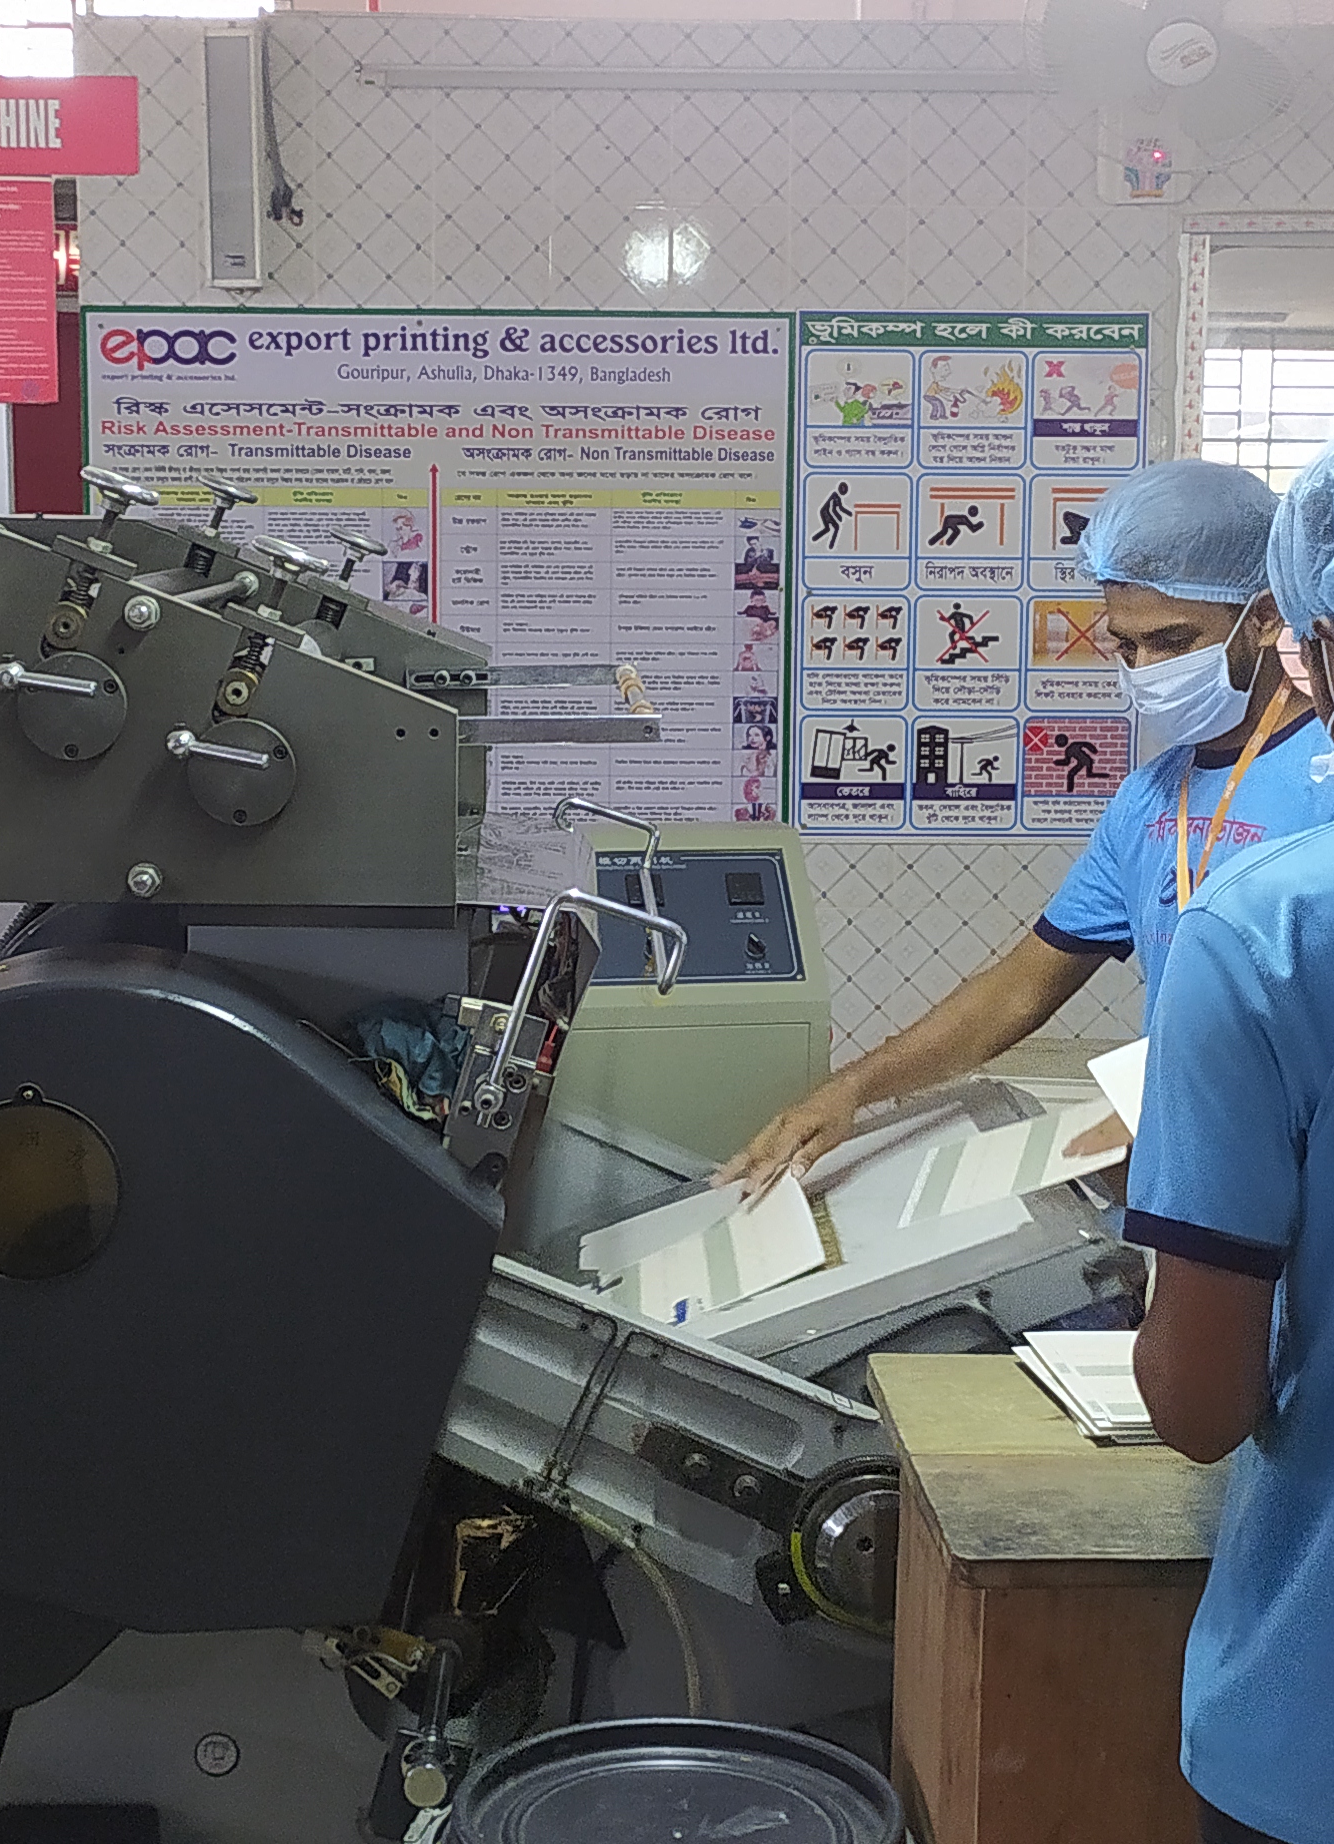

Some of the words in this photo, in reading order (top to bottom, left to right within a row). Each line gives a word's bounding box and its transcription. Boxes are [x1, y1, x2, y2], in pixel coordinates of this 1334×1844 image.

[807, 316, 925, 343] ভূমিকম্প
[933, 321, 990, 341] হলে
[999, 317, 1041, 340] কী
[1044, 322, 1144, 341] করবেন
[100, 328, 237, 370] epac
[248, 327, 351, 357] export
[362, 325, 489, 359] printing
[499, 326, 530, 352] &
[540, 328, 718, 354] accessories
[729, 329, 779, 355] ltd.
[337, 364, 411, 382] Gouripur,
[417, 365, 477, 383] Ashulia,
[484, 365, 583, 385] Dhaka-1349,
[591, 367, 671, 385] Bangladesh
[114, 397, 170, 418] রিস্ক
[473, 404, 533, 420] এবং
[540, 404, 689, 421] অসংক্রামক
[700, 405, 762, 422] রোগ
[101, 420, 146, 436] Risk
[154, 421, 437, 439] Assessment-Transmittable
[445, 424, 484, 439] and
[491, 424, 533, 439] Non
[541, 424, 685, 441] Transmittable
[692, 425, 775, 442] Disease
[103, 444, 170, 459] সংক্রামক
[228, 443, 340, 459] Transmittable
[347, 445, 412, 459] Disease
[462, 447, 532, 461] অসংক্রামক
[580, 446, 610, 461] Non
[615, 446, 713, 462] Transmittable
[717, 447, 775, 462] Disease
[840, 565, 874, 583] বসুন
[925, 561, 966, 580] নিরাপদ
[968, 566, 1014, 584] অবস্থানে
